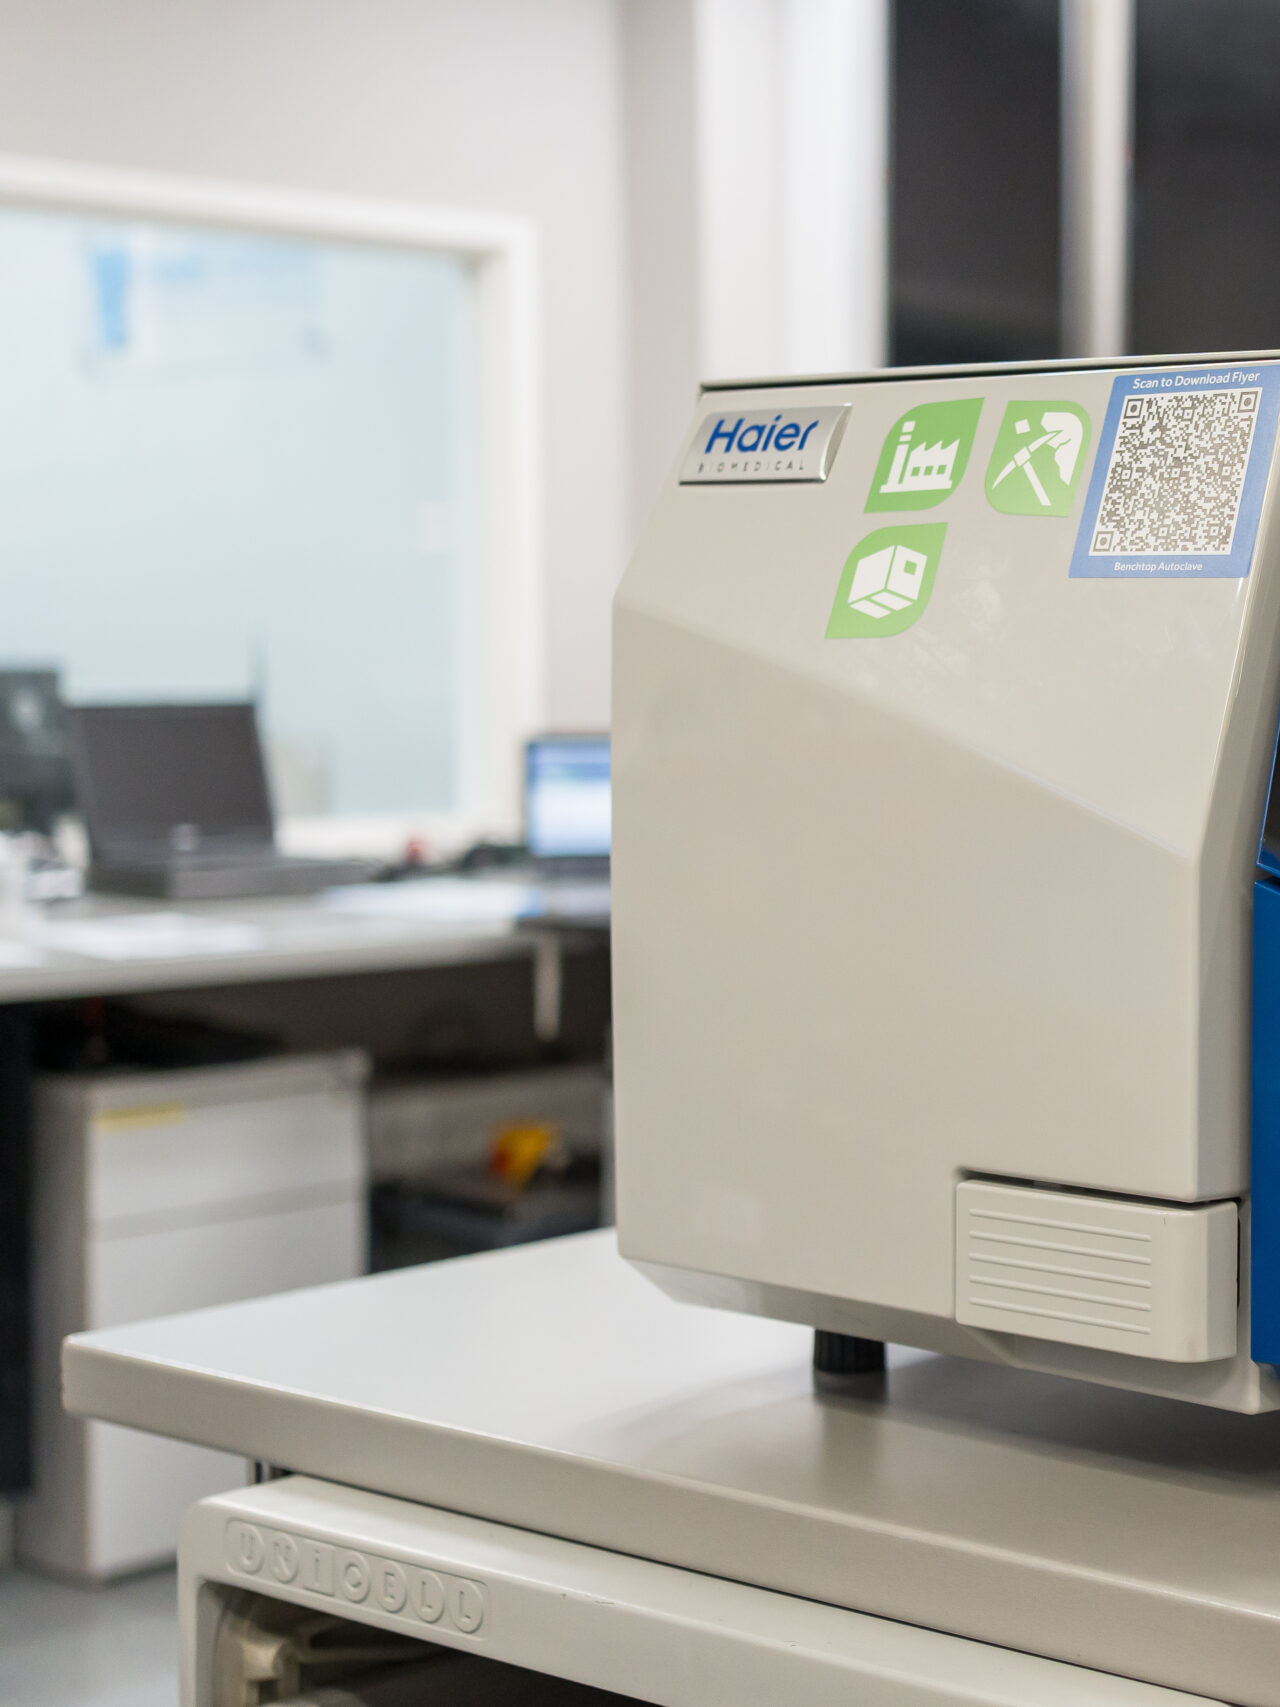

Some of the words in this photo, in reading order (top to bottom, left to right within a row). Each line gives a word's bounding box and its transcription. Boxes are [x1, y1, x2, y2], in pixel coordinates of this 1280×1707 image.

[1132, 378, 1159, 390] Scan
[1161, 378, 1173, 388] to
[1174, 371, 1230, 387] Download
[1231, 371, 1261, 385] Flyer
[704, 414, 820, 455] Haier
[698, 460, 805, 474] BIOMEDICAL
[1113, 561, 1157, 573] Benchtop
[1158, 561, 1204, 571] Autoclave
